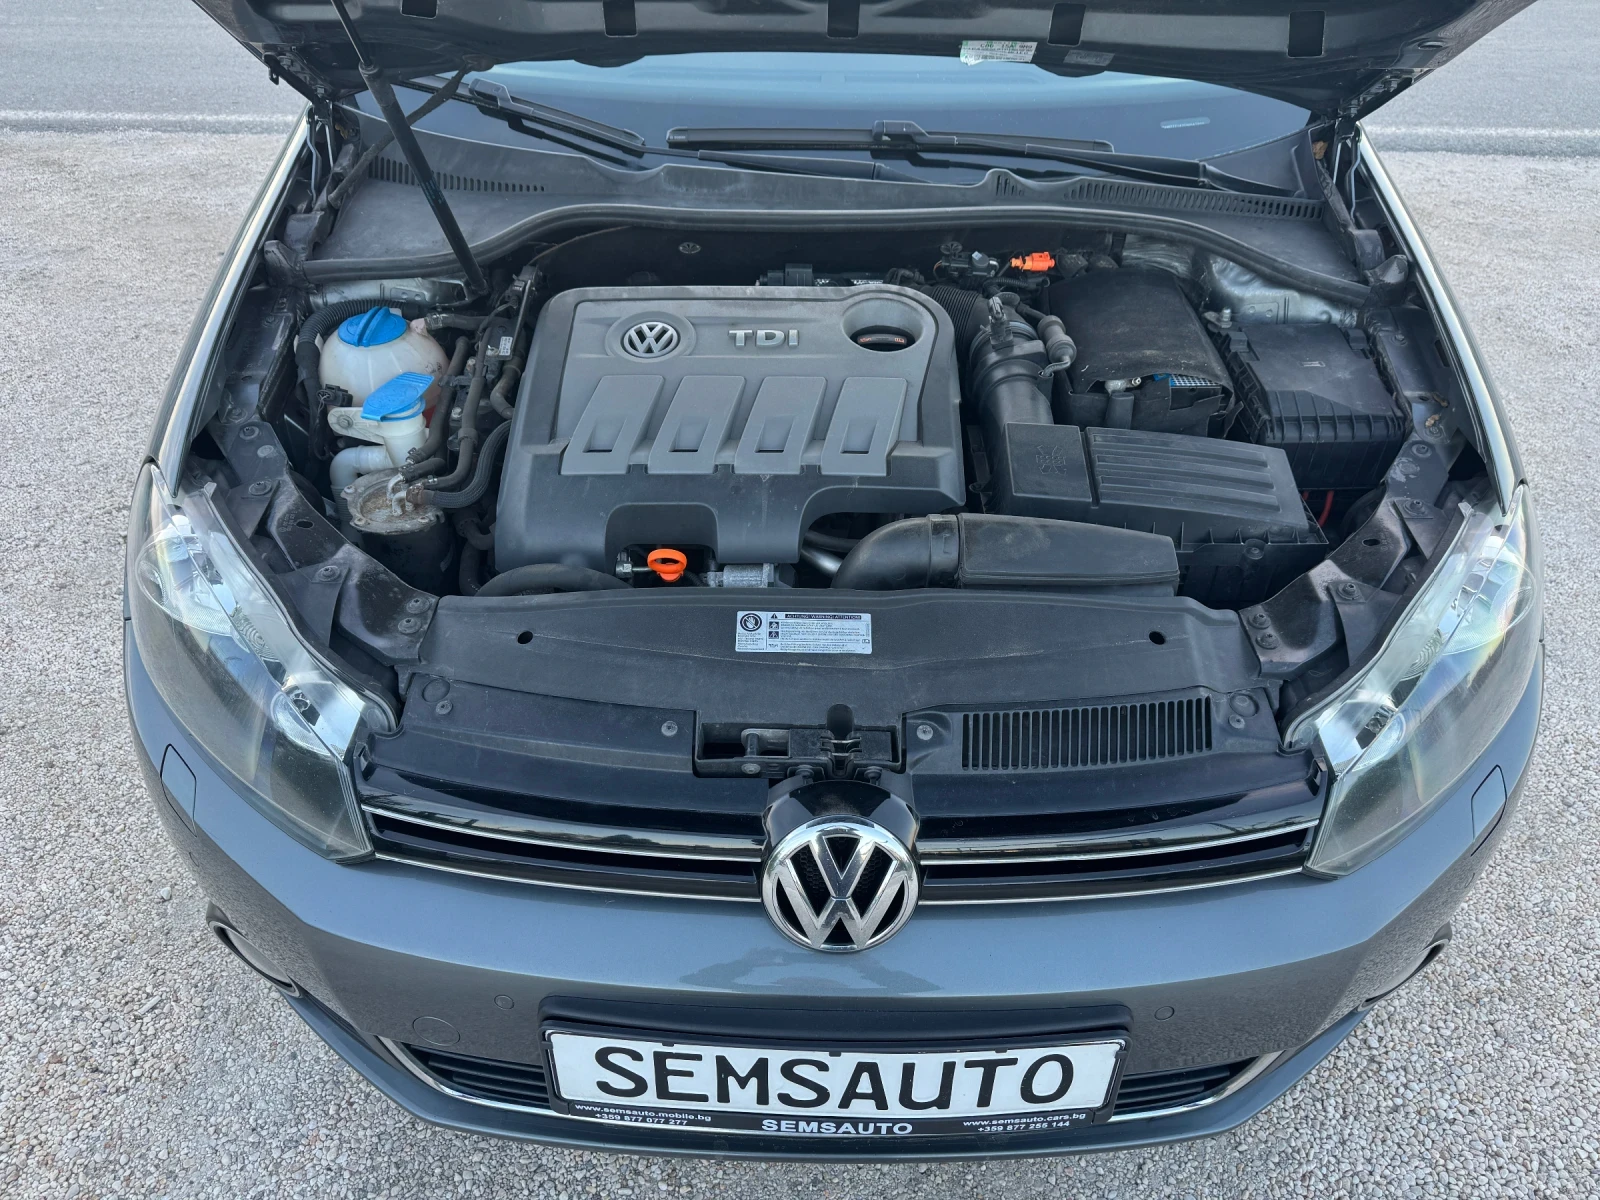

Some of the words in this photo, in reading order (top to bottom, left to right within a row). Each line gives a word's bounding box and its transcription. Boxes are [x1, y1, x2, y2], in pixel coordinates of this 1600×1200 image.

[728, 329, 799, 347] TDI
[594, 1046, 1075, 1111] SEMSAUTO
[574, 1104, 712, 1122] www.semsauto.mobile.bg
[963, 1113, 1086, 1126] www.semsauto.cars.bg
[668, 1118, 687, 1126] 277
[761, 1119, 913, 1135] SEMSAUTO
[1051, 1120, 1070, 1128] 144
